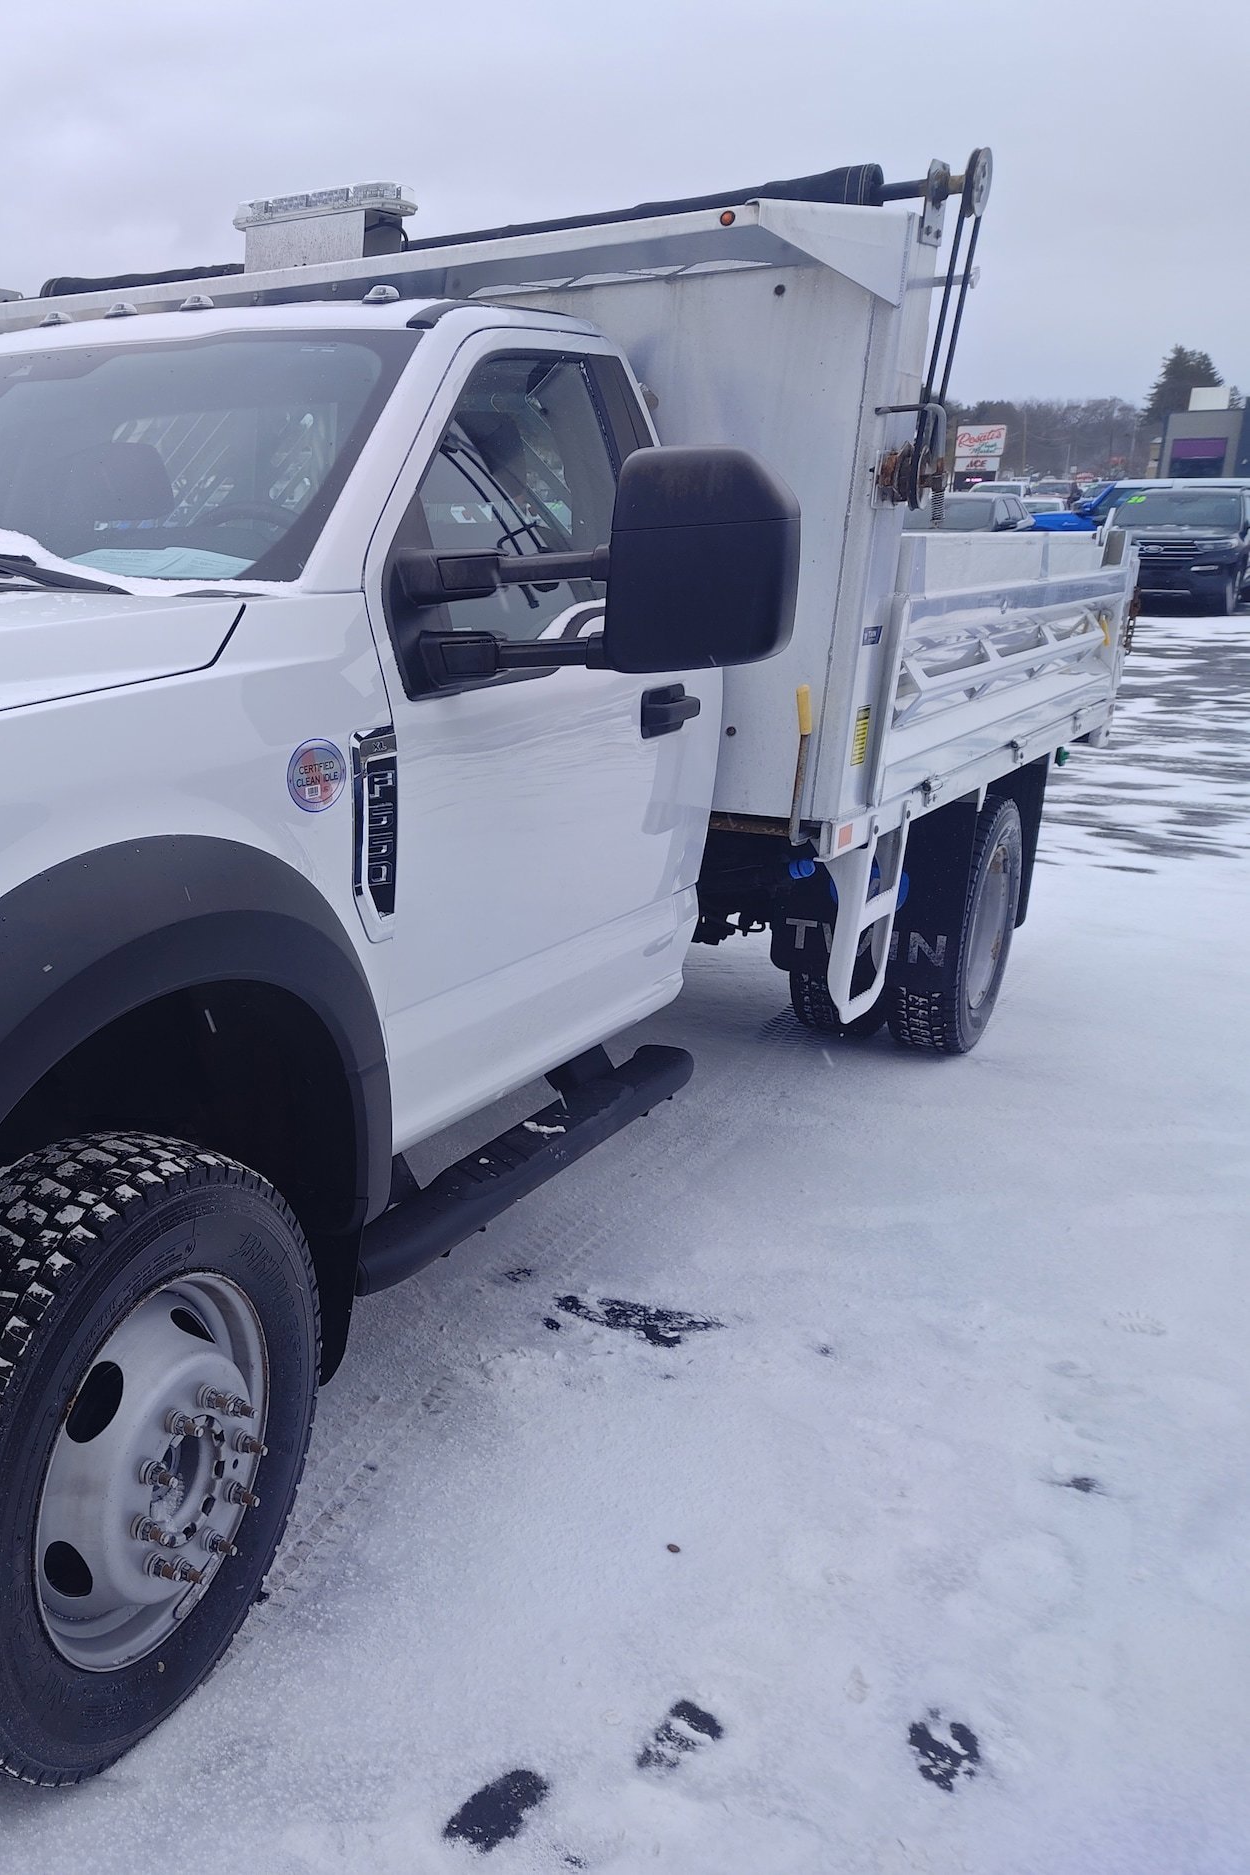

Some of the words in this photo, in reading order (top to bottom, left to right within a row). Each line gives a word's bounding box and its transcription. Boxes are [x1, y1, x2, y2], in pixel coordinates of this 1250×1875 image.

[966, 459, 987, 468] ACE
[371, 741, 388, 752] XL
[298, 760, 335, 775] CERTIFIED
[296, 774, 321, 788] CLEAN
[323, 771, 339, 783] IDLE
